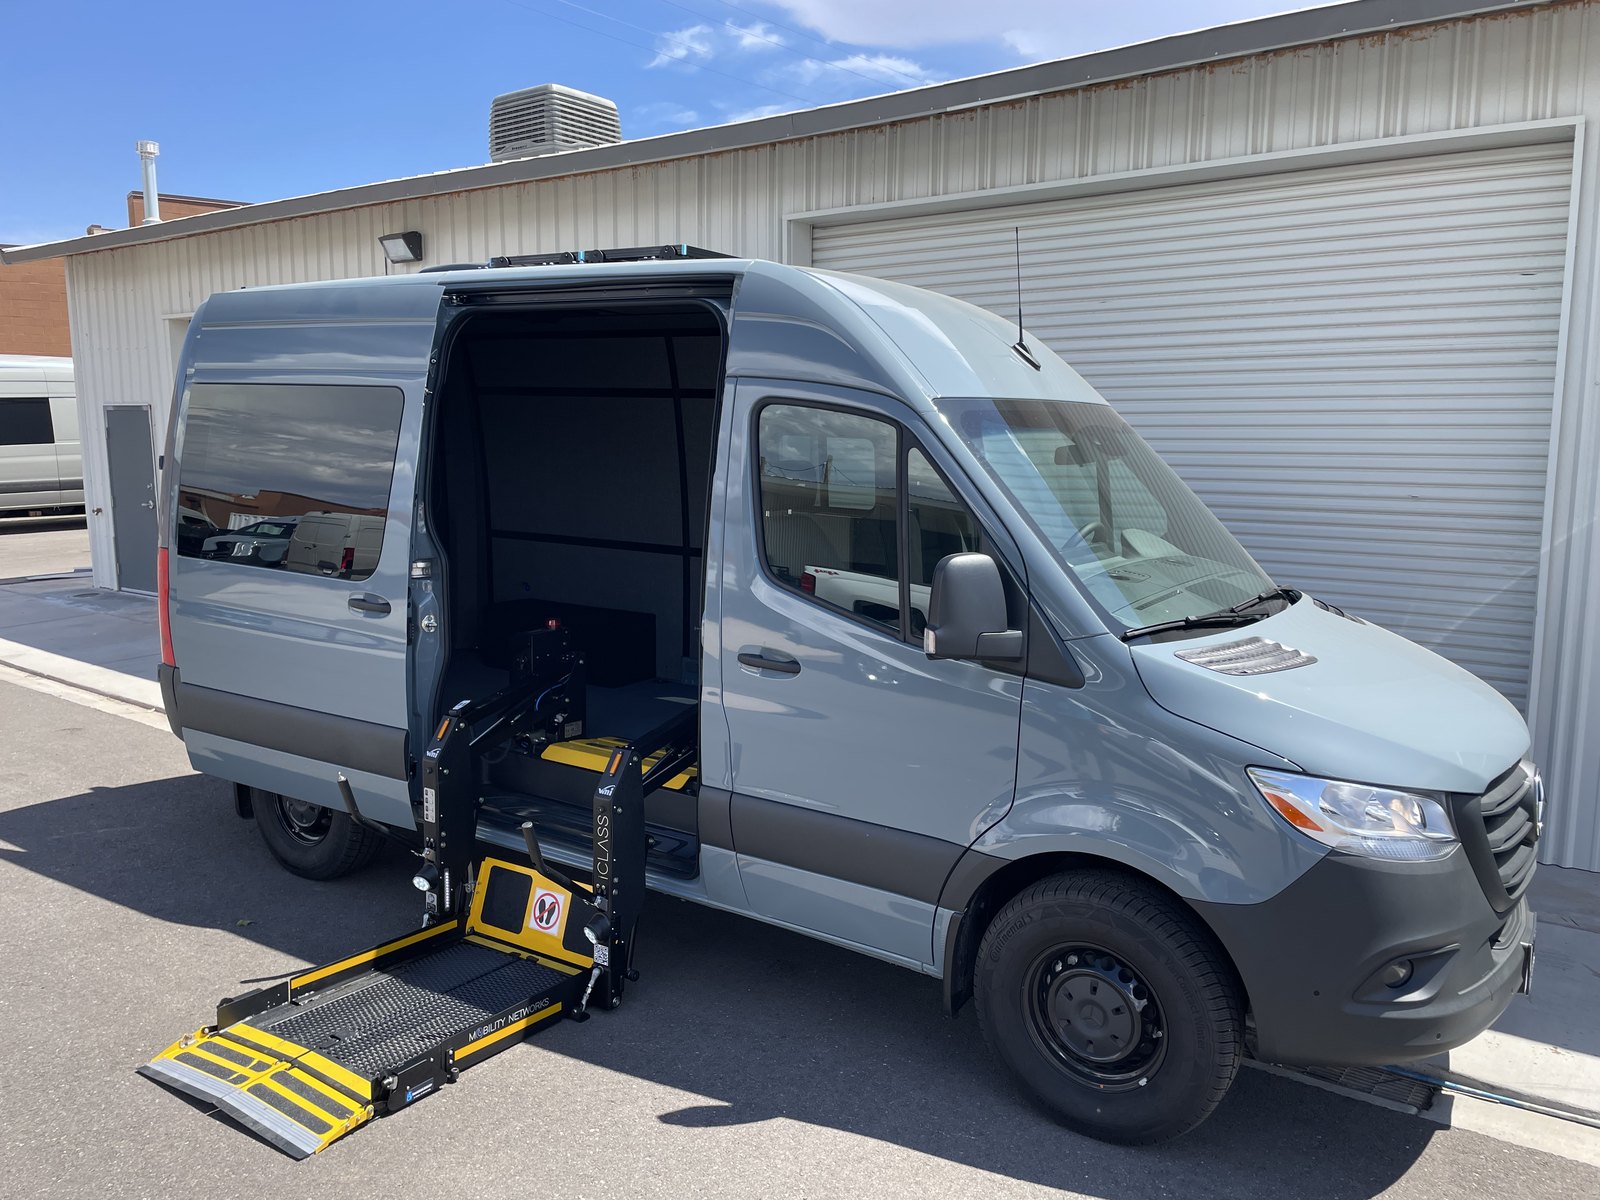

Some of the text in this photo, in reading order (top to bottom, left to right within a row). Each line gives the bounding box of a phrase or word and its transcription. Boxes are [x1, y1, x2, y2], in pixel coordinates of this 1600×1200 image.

[989, 915, 1027, 963] Continental
[468, 997, 550, 1042] MOBILITY NETWORKS
